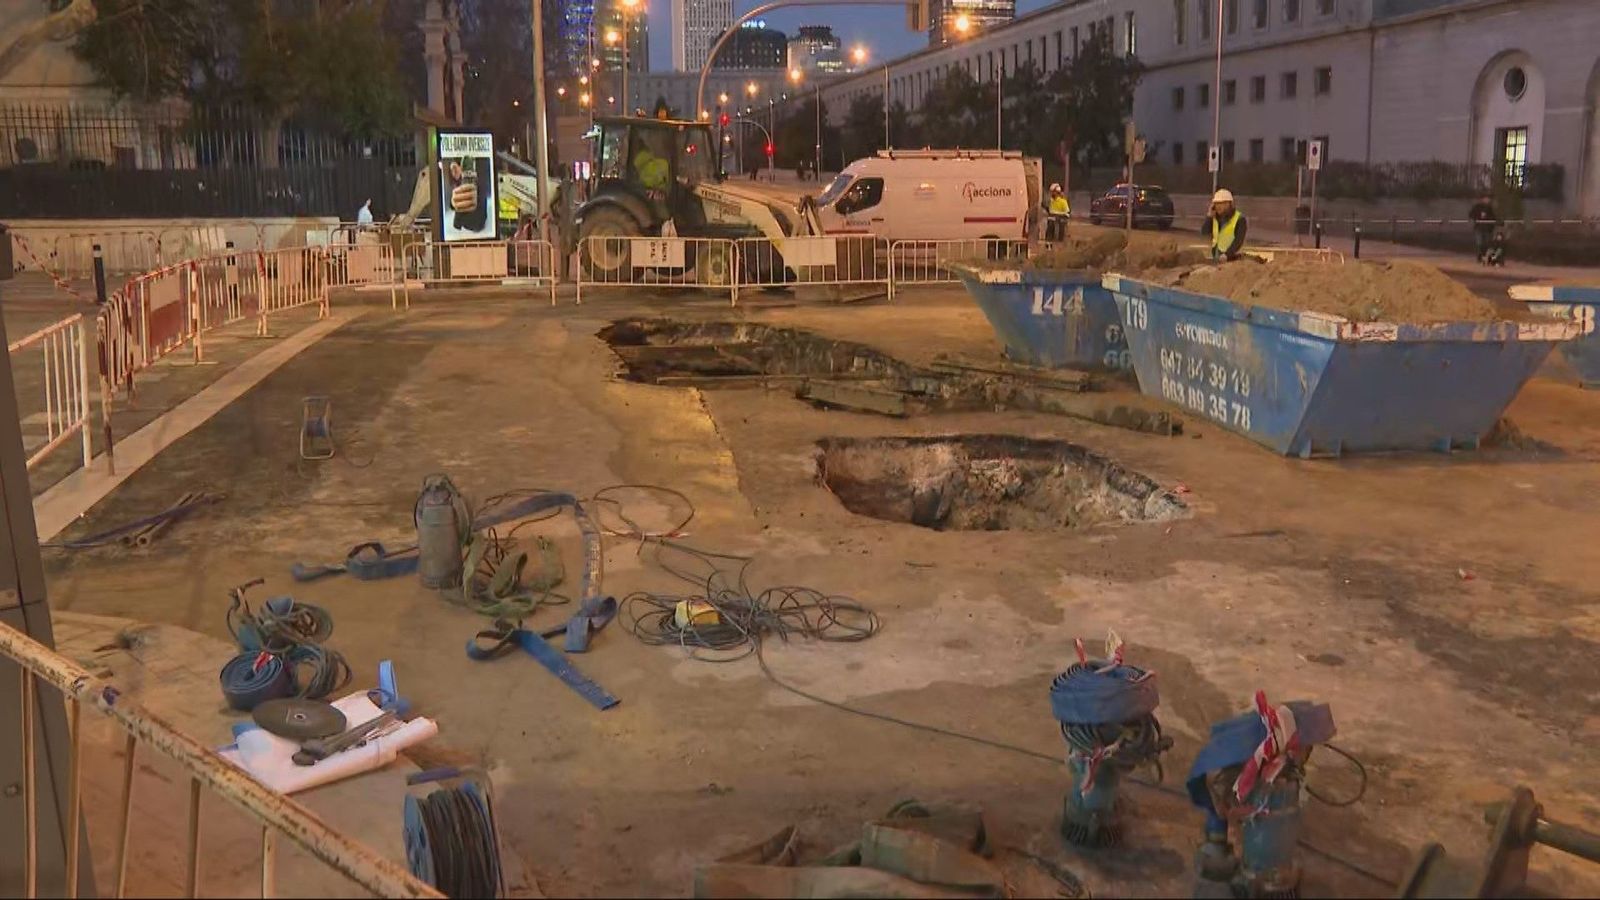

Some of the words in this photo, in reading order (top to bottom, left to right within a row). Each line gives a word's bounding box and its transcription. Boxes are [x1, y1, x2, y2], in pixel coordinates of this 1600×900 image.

[973, 187, 1011, 198] acciona
[1032, 286, 1085, 316] 144
[1126, 297, 1148, 330] 179
[1209, 363, 1227, 391] 39
[1209, 394, 1227, 423] 35
[1231, 402, 1251, 431] 78
